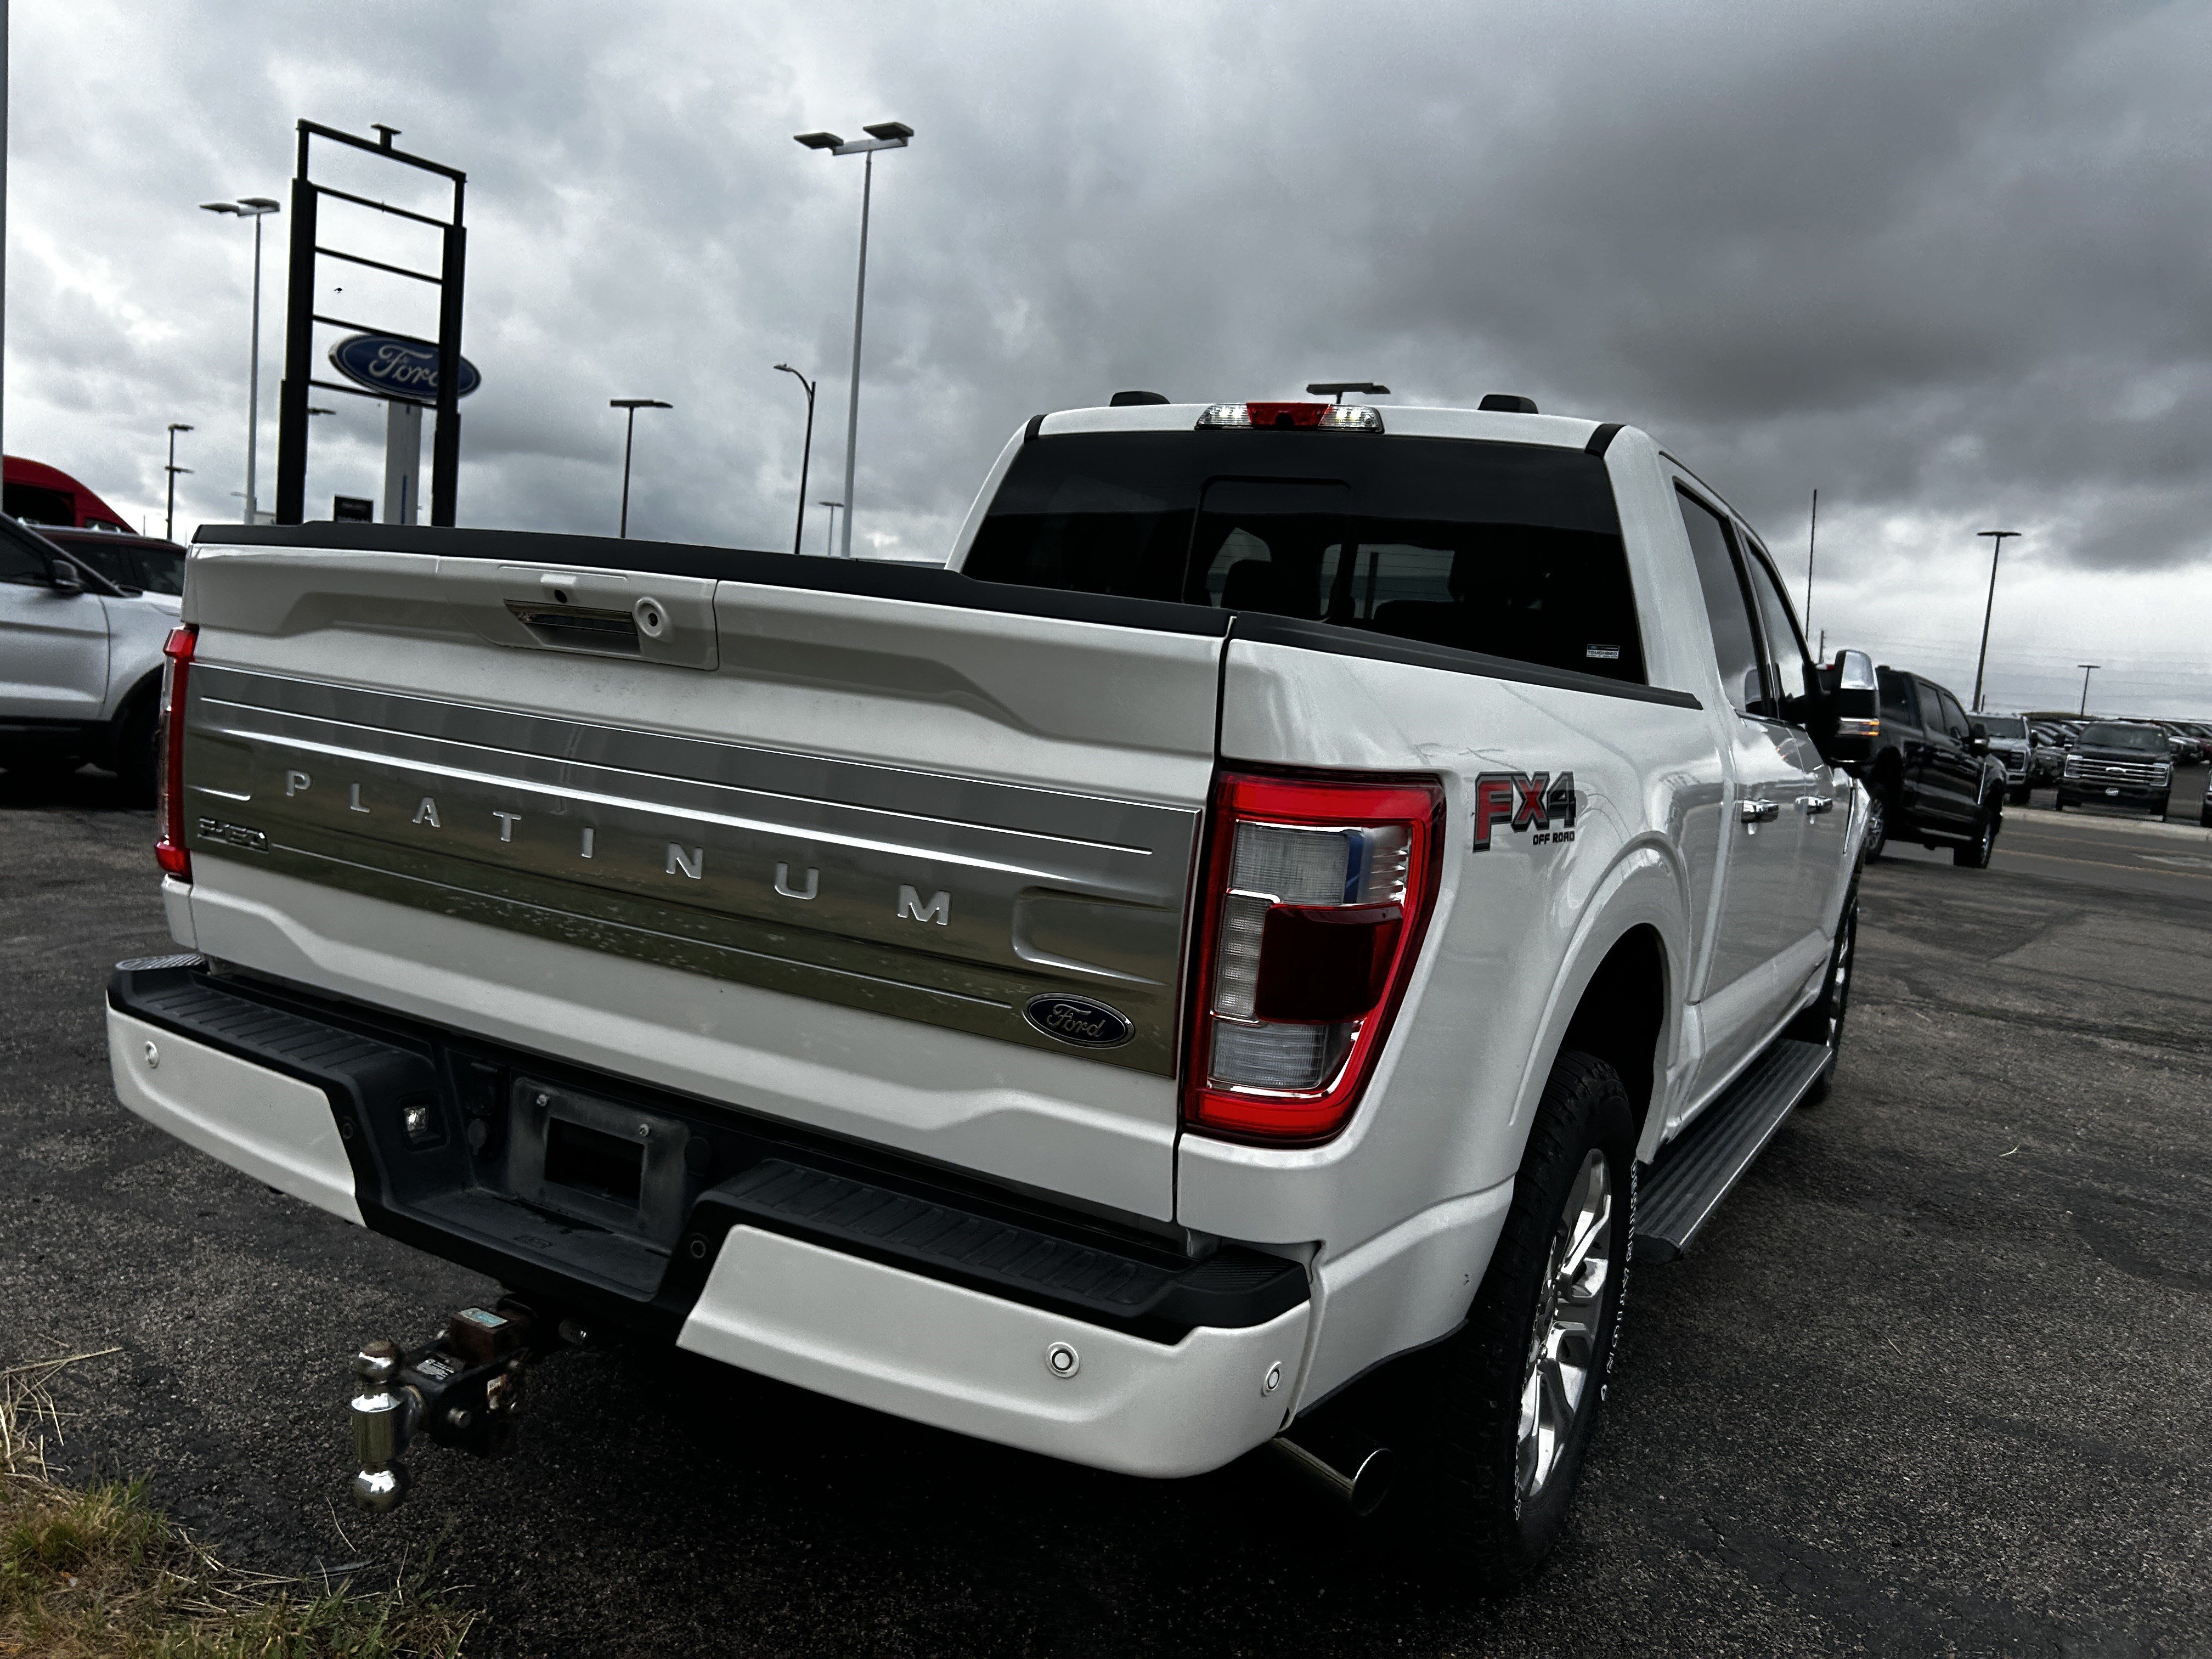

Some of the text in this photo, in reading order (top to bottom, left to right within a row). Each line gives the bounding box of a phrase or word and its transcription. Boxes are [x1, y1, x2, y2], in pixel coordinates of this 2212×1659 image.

[1472, 771, 1576, 853] FX4
[1533, 831, 1575, 845] OFF ROAD
[286, 769, 952, 926] PLATINUM
[1046, 1003, 1106, 1037] Ford
